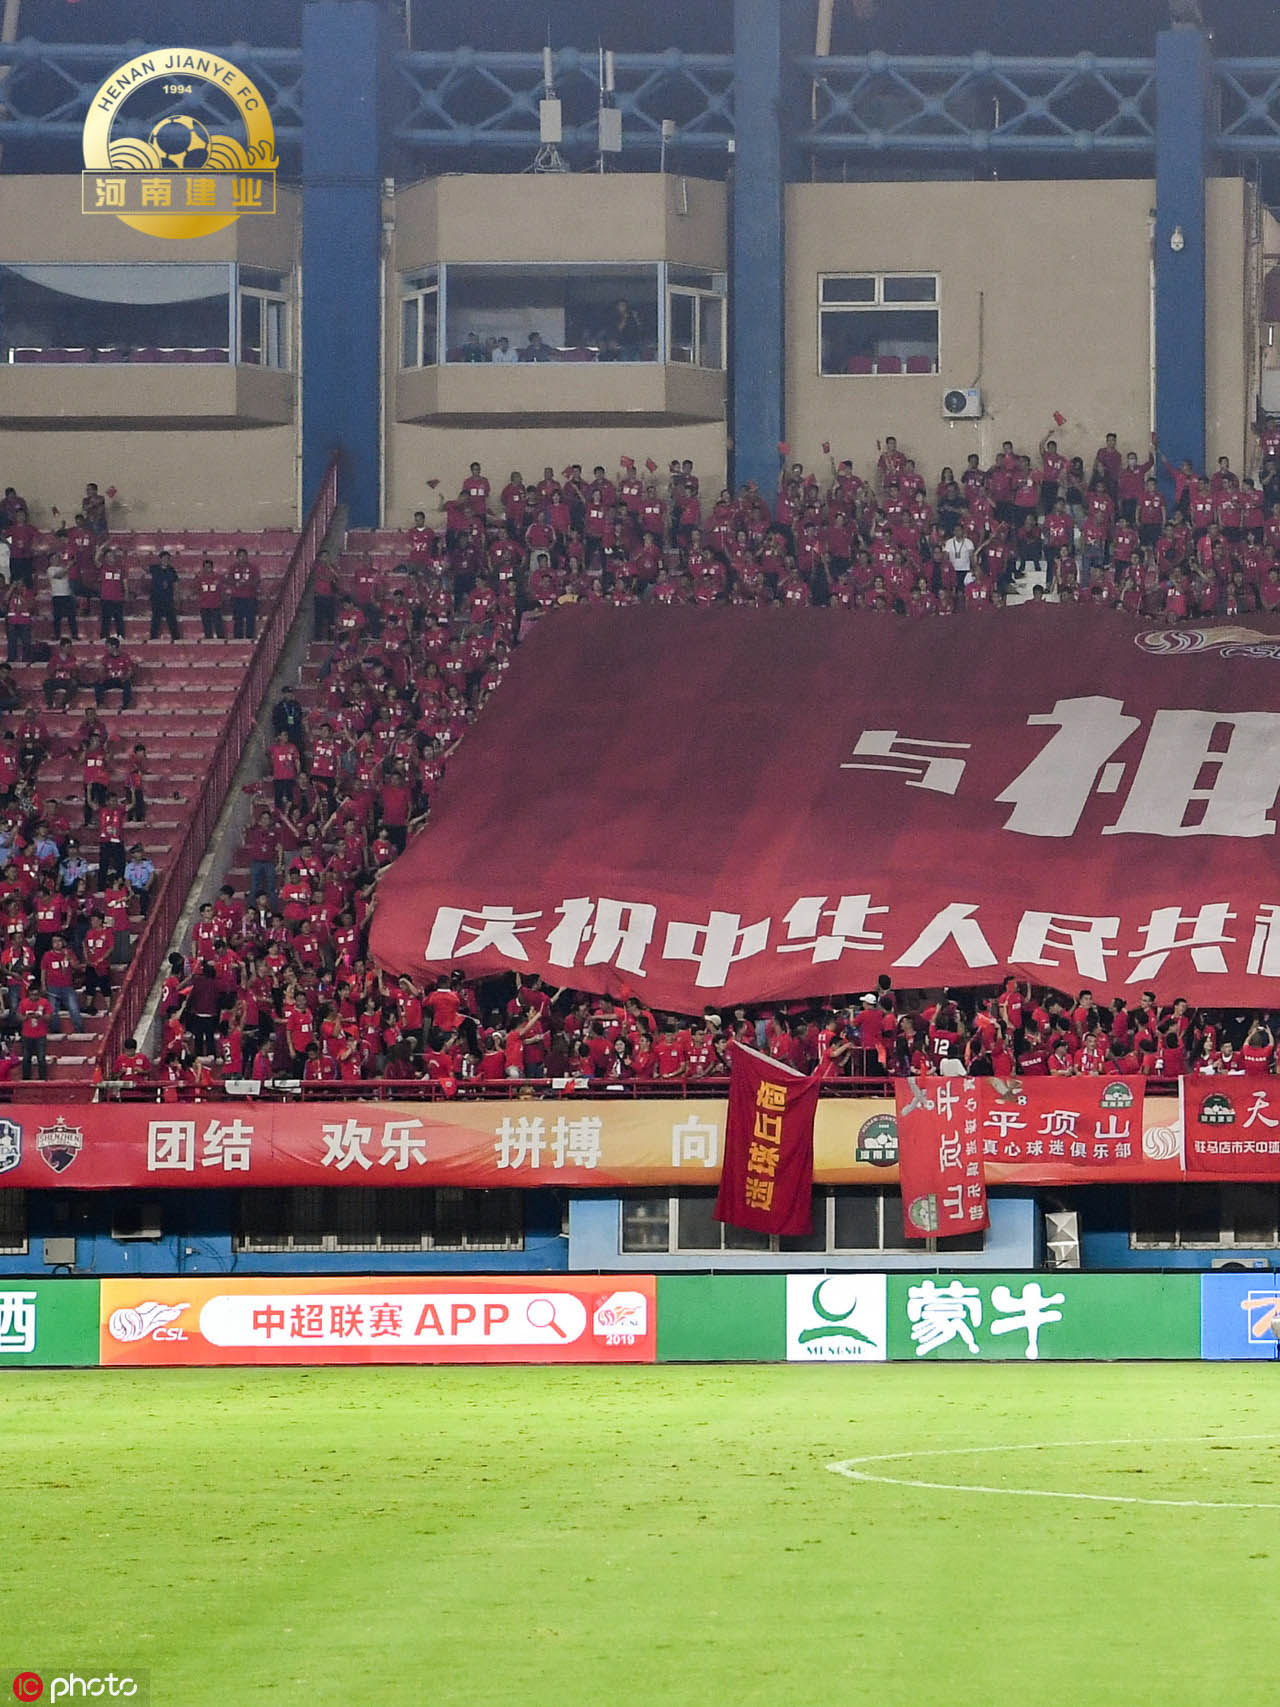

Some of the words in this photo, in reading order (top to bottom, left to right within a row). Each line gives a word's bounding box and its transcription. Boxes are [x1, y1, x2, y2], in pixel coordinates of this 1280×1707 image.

[933, 1037, 950, 1056] 12
[983, 1109, 1130, 1139] 平顶山
[147, 1119, 254, 1172] 团结
[320, 1118, 429, 1171] 欢乐
[494, 1115, 602, 1170] 拼搏
[671, 1114, 718, 1168] 向
[982, 1139, 1132, 1159] 真心球迷俱乐部
[907, 1280, 1066, 1360] 蒙牛
[151, 1327, 189, 1342] CSL
[605, 1334, 636, 1346] 2019
